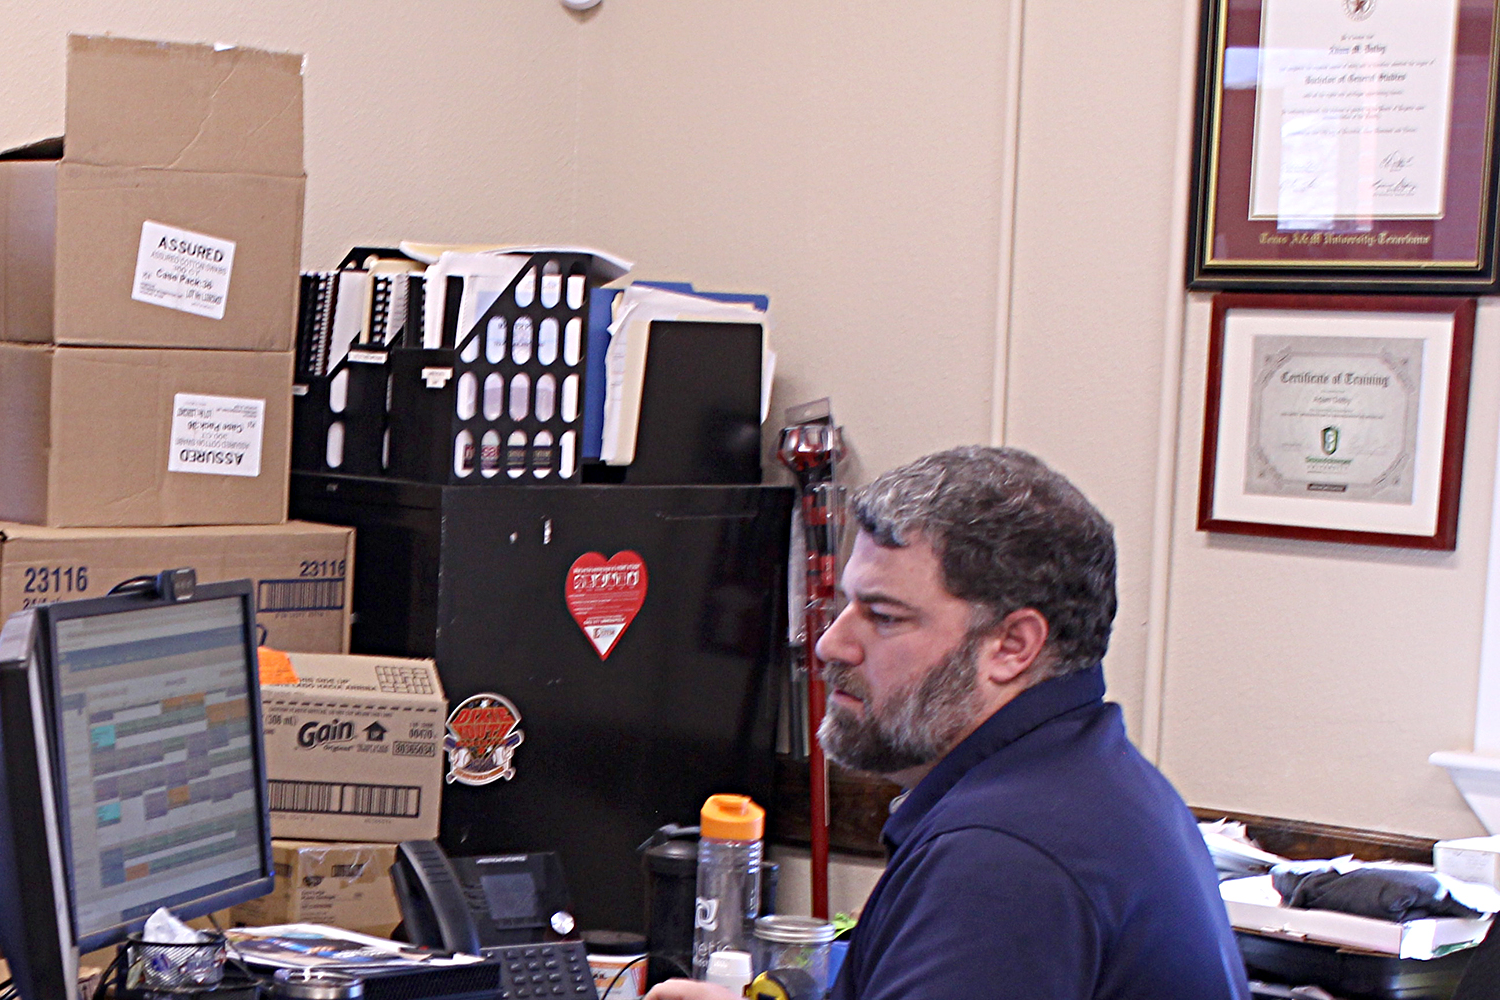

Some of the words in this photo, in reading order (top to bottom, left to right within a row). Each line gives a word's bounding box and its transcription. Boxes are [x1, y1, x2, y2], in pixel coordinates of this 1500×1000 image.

[1259, 233, 1288, 244] Texas
[158, 235, 224, 264] ASSURED
[156, 269, 178, 284] Case
[1281, 371, 1330, 385] Certificate
[1332, 373, 1342, 385] of
[1344, 372, 1390, 388] Training
[180, 448, 244, 467] ASSURED
[300, 559, 346, 577] 23116
[24, 566, 88, 593] 23116
[297, 718, 355, 749] Gain
